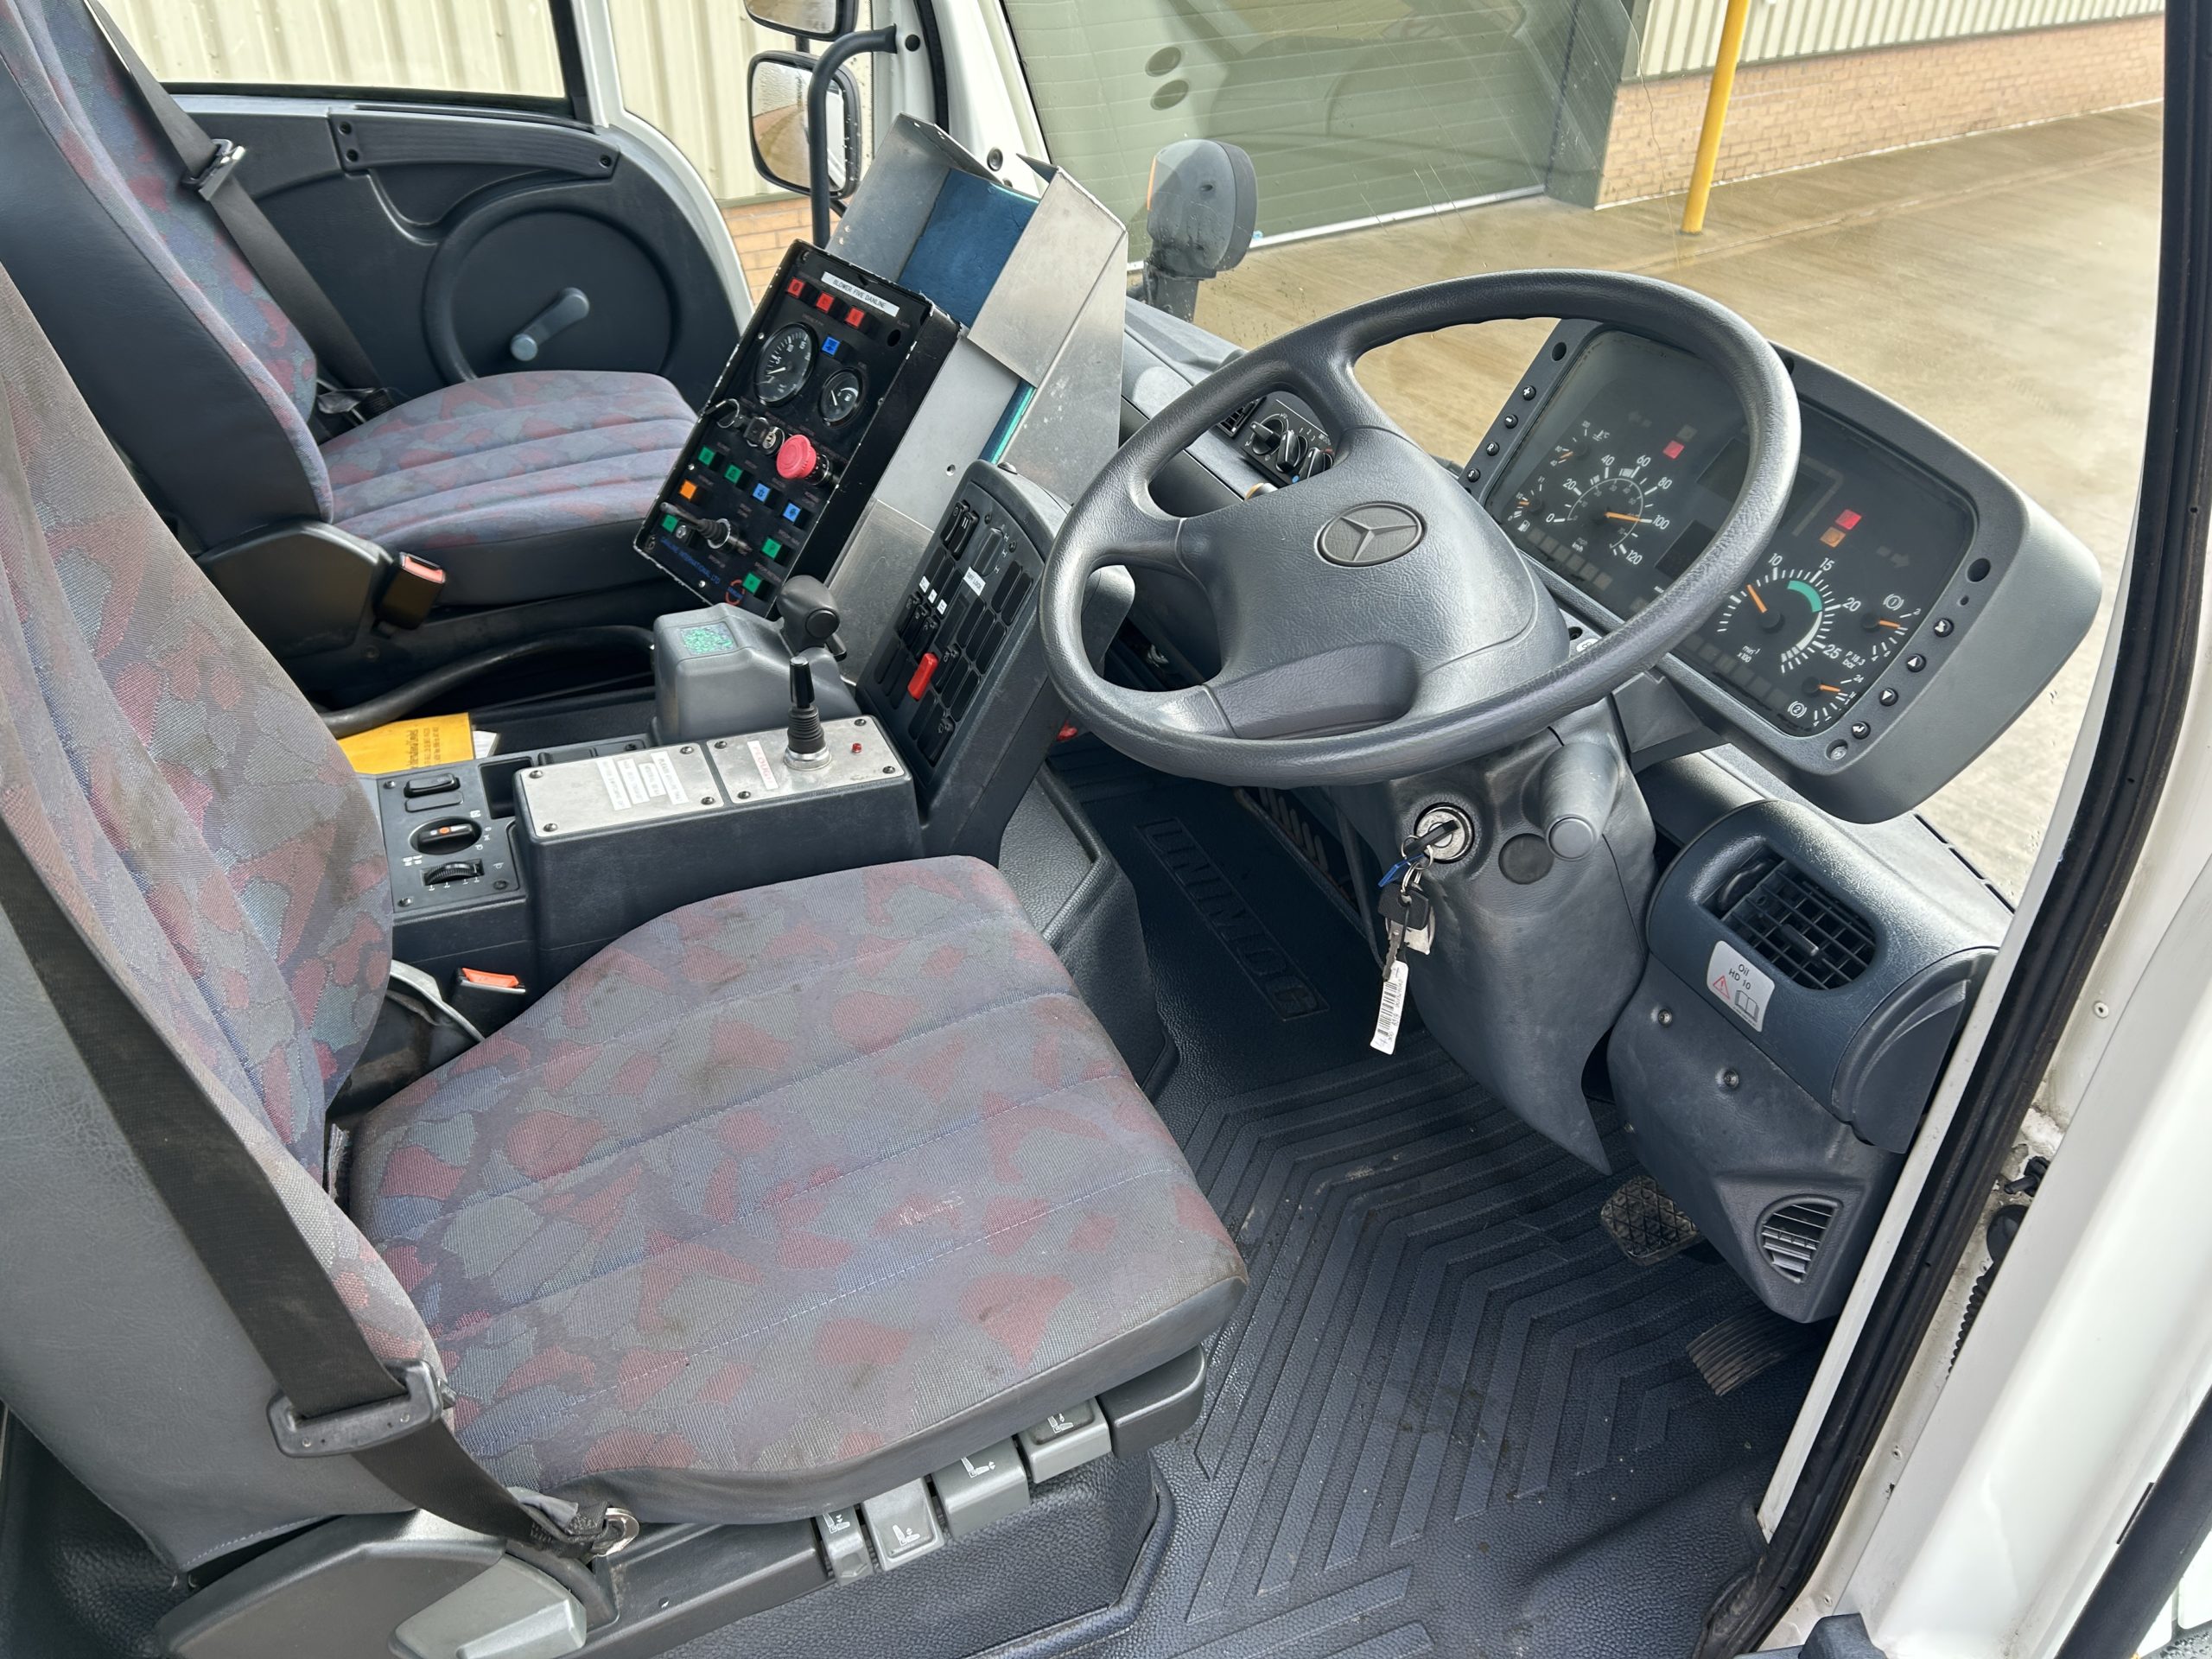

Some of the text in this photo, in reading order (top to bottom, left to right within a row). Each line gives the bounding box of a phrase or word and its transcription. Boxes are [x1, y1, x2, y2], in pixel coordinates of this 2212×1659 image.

[833, 279, 852, 293] BLOWER
[854, 289, 865, 299] FIVE
[864, 294, 886, 308] DANLINE
[1601, 454, 1615, 466] 40
[1637, 455, 1651, 467] 60
[1563, 478, 1576, 490] 20
[1658, 477, 1672, 490] 80
[1546, 514, 1554, 523] 0
[1652, 517, 1669, 530] 100
[1626, 550, 1643, 564] 120
[1768, 552, 1783, 566] 10
[1819, 557, 1835, 571] 15
[1842, 597, 1861, 612] 20
[1737, 652, 1751, 663] x100
[1823, 644, 1842, 659] 25
[1842, 658, 1856, 669] bar
[1853, 674, 1864, 683] 24
[753, 745, 772, 782] PLOUGH
[1142, 820, 1319, 1014] UNIMOG
[1738, 963, 1750, 976] Oil
[1728, 968, 1751, 990] HD 10
